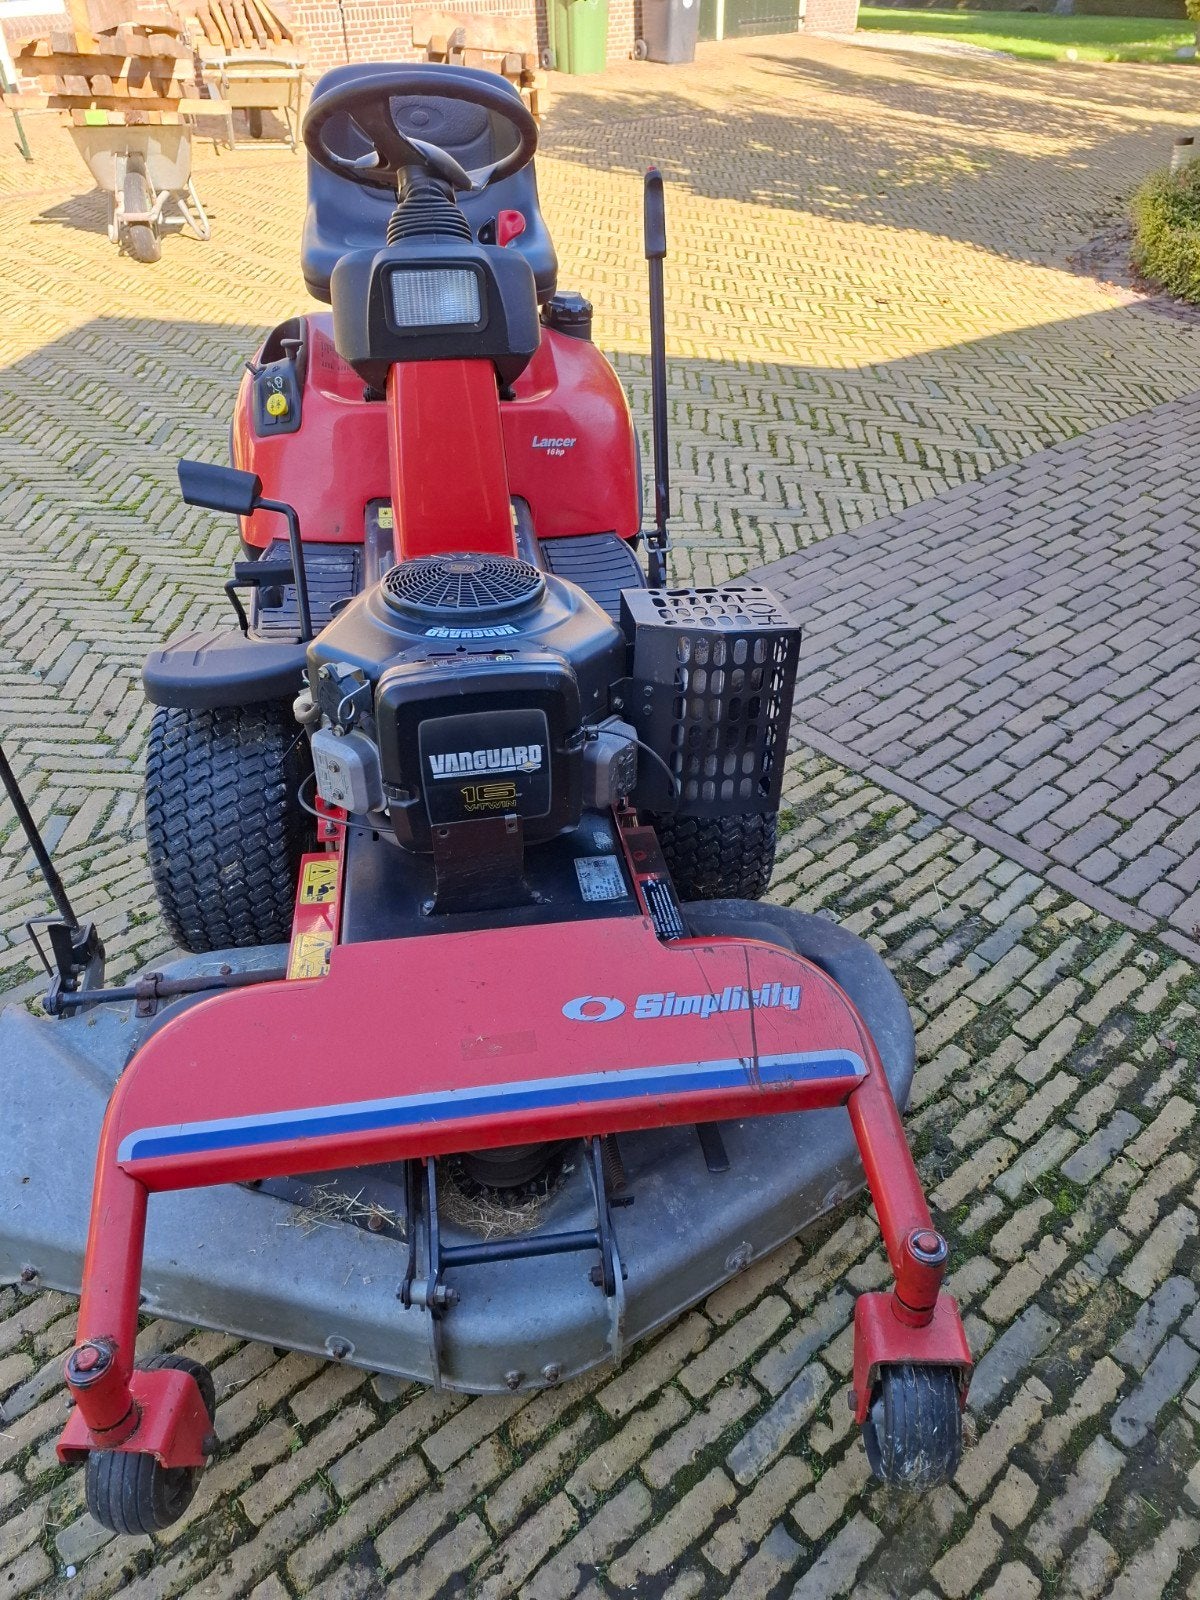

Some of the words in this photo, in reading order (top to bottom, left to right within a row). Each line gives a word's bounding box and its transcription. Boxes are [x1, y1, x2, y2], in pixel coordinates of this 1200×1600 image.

[531, 435, 577, 448] Lancer
[425, 624, 520, 638] VANGUARD
[428, 744, 542, 774] VANGUARD
[460, 782, 516, 803] 16
[633, 981, 802, 1020] Simplicity
